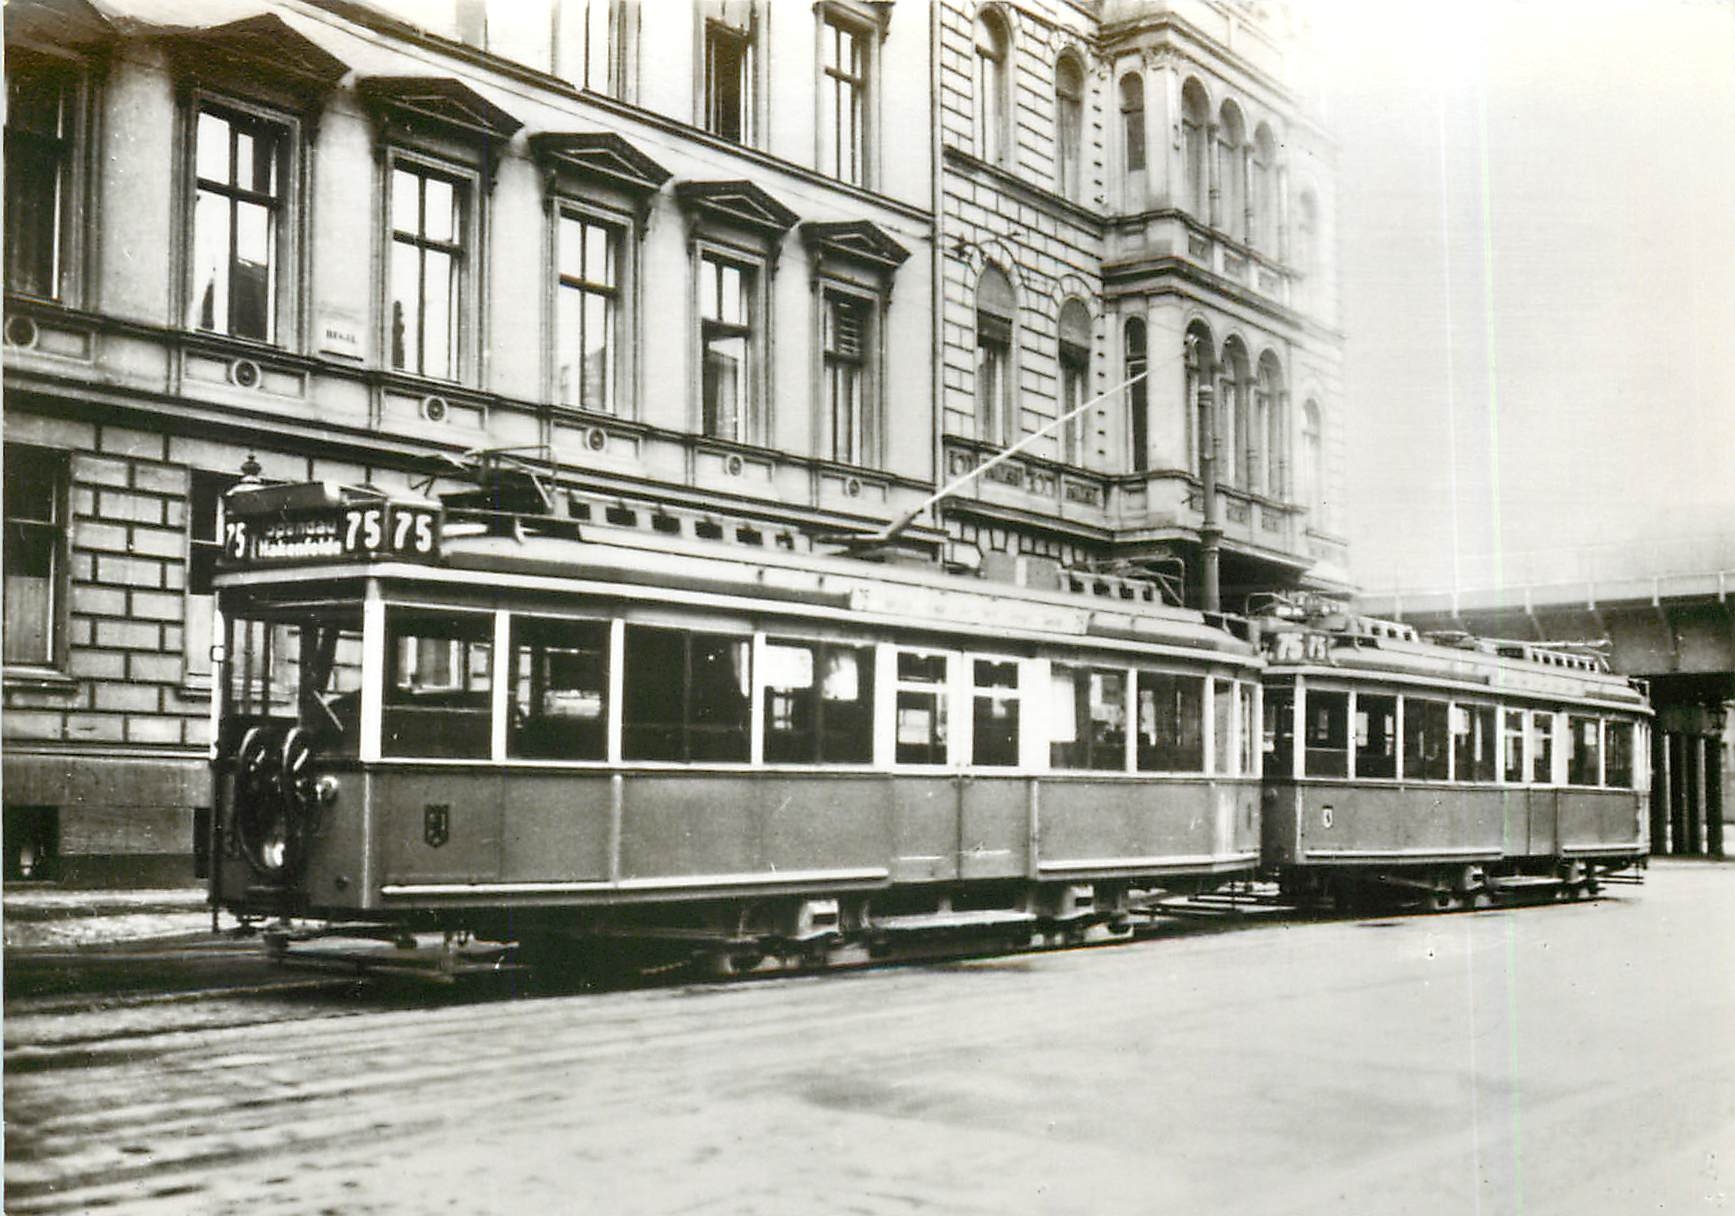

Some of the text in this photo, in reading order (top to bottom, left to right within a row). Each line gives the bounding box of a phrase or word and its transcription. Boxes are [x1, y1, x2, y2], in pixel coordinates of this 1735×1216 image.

[226, 522, 246, 557] 75
[345, 510, 381, 550] 75
[394, 511, 433, 552] 75
